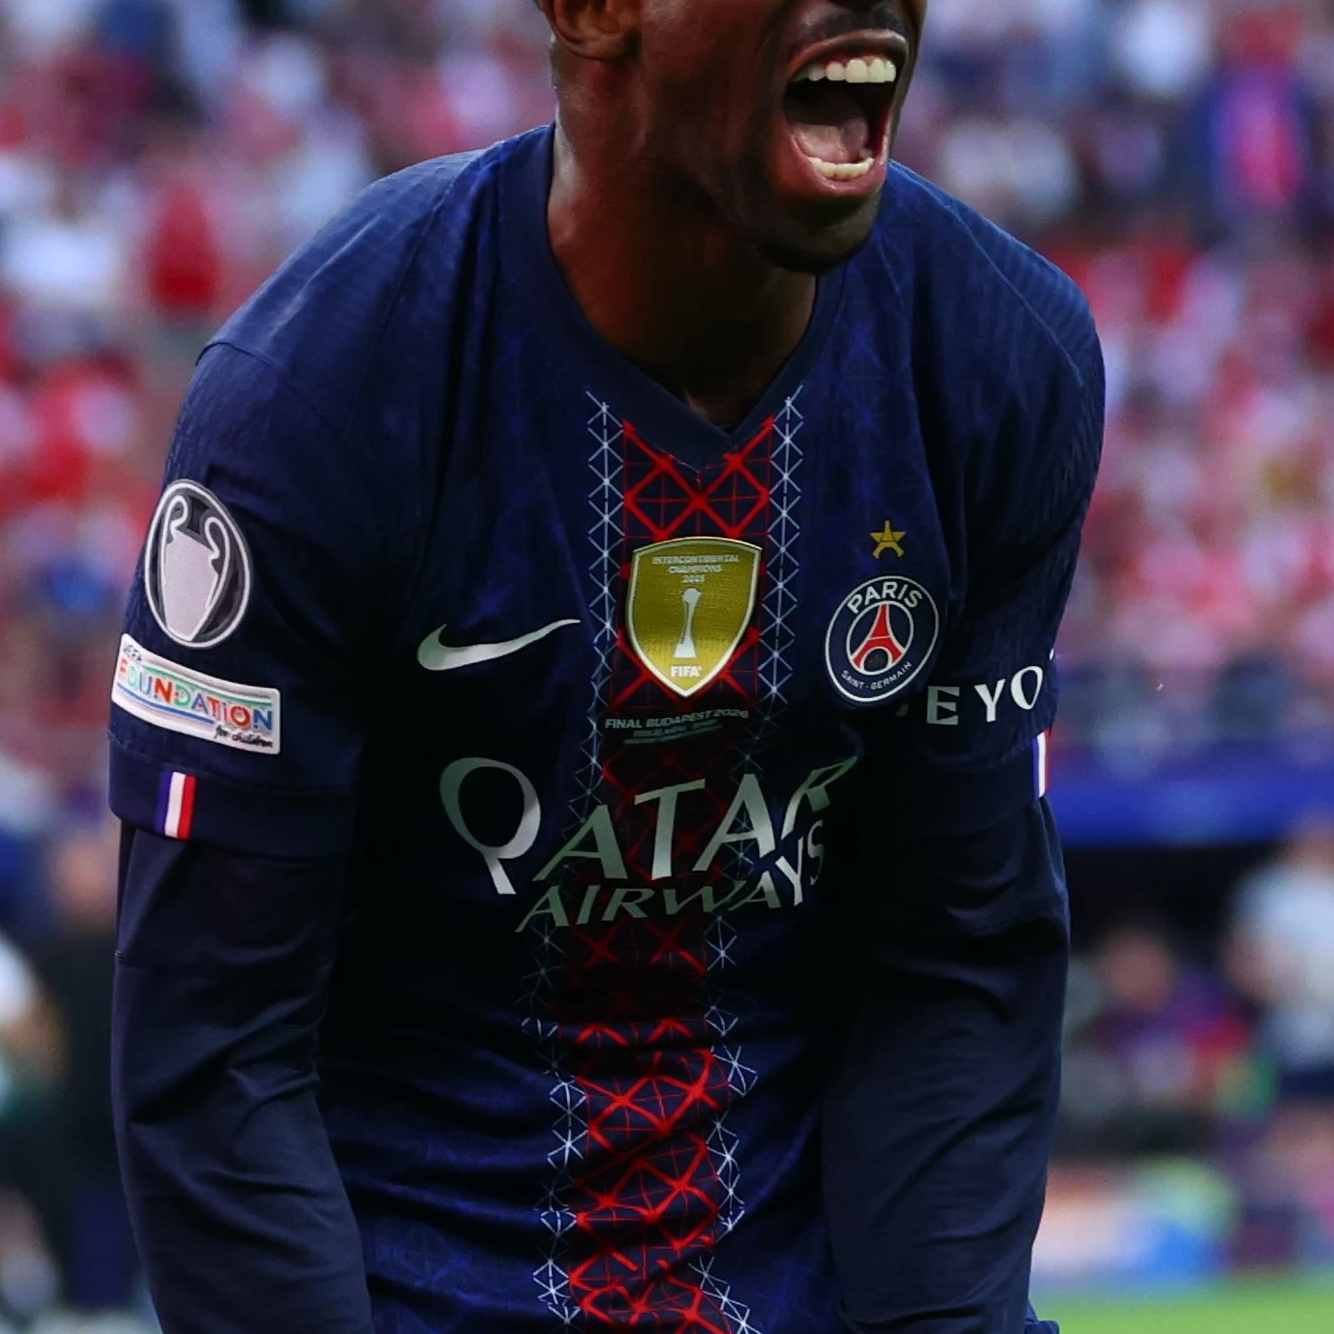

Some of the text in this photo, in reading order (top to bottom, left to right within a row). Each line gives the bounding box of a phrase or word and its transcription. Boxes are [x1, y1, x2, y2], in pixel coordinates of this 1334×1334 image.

[847, 581, 923, 614] PARIS
[670, 666, 700, 678] FIFA
[605, 718, 643, 729] FINAL
[646, 710, 713, 727] BUDAPEST
[713, 708, 749, 718] 2026
[439, 755, 858, 895] QATAR
[515, 819, 824, 932] AIRWAYS
